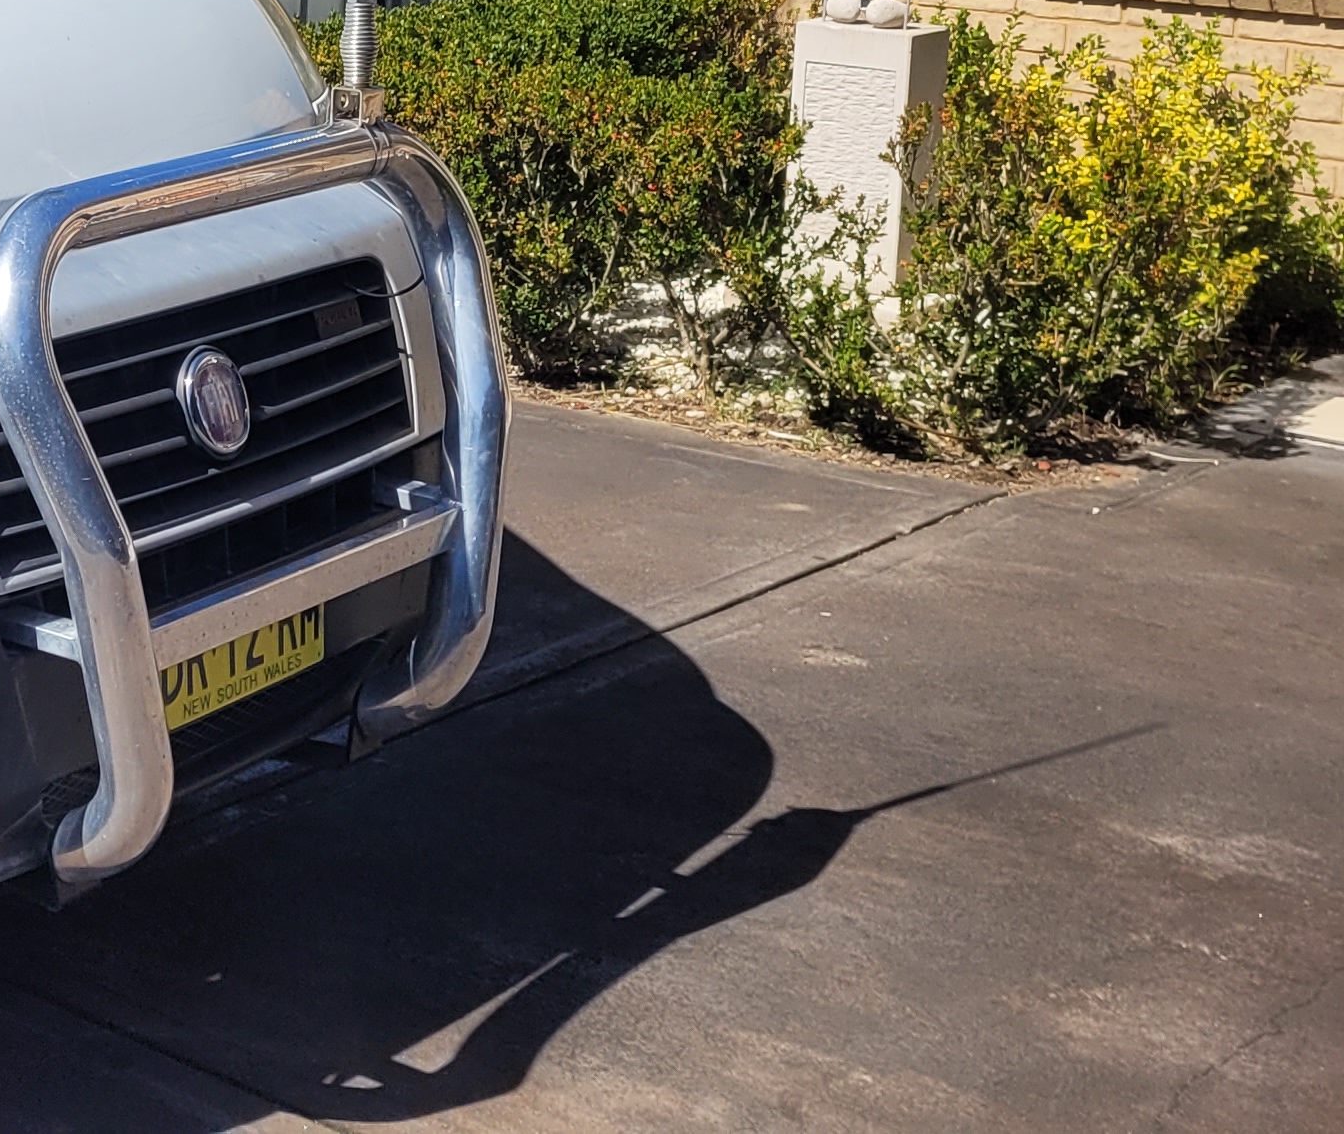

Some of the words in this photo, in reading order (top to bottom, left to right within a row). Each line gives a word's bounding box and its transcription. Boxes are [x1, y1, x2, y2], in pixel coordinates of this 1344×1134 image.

[183, 693, 212, 718] NEW
[217, 672, 259, 704] SOUTH
[264, 652, 302, 679] WALES
